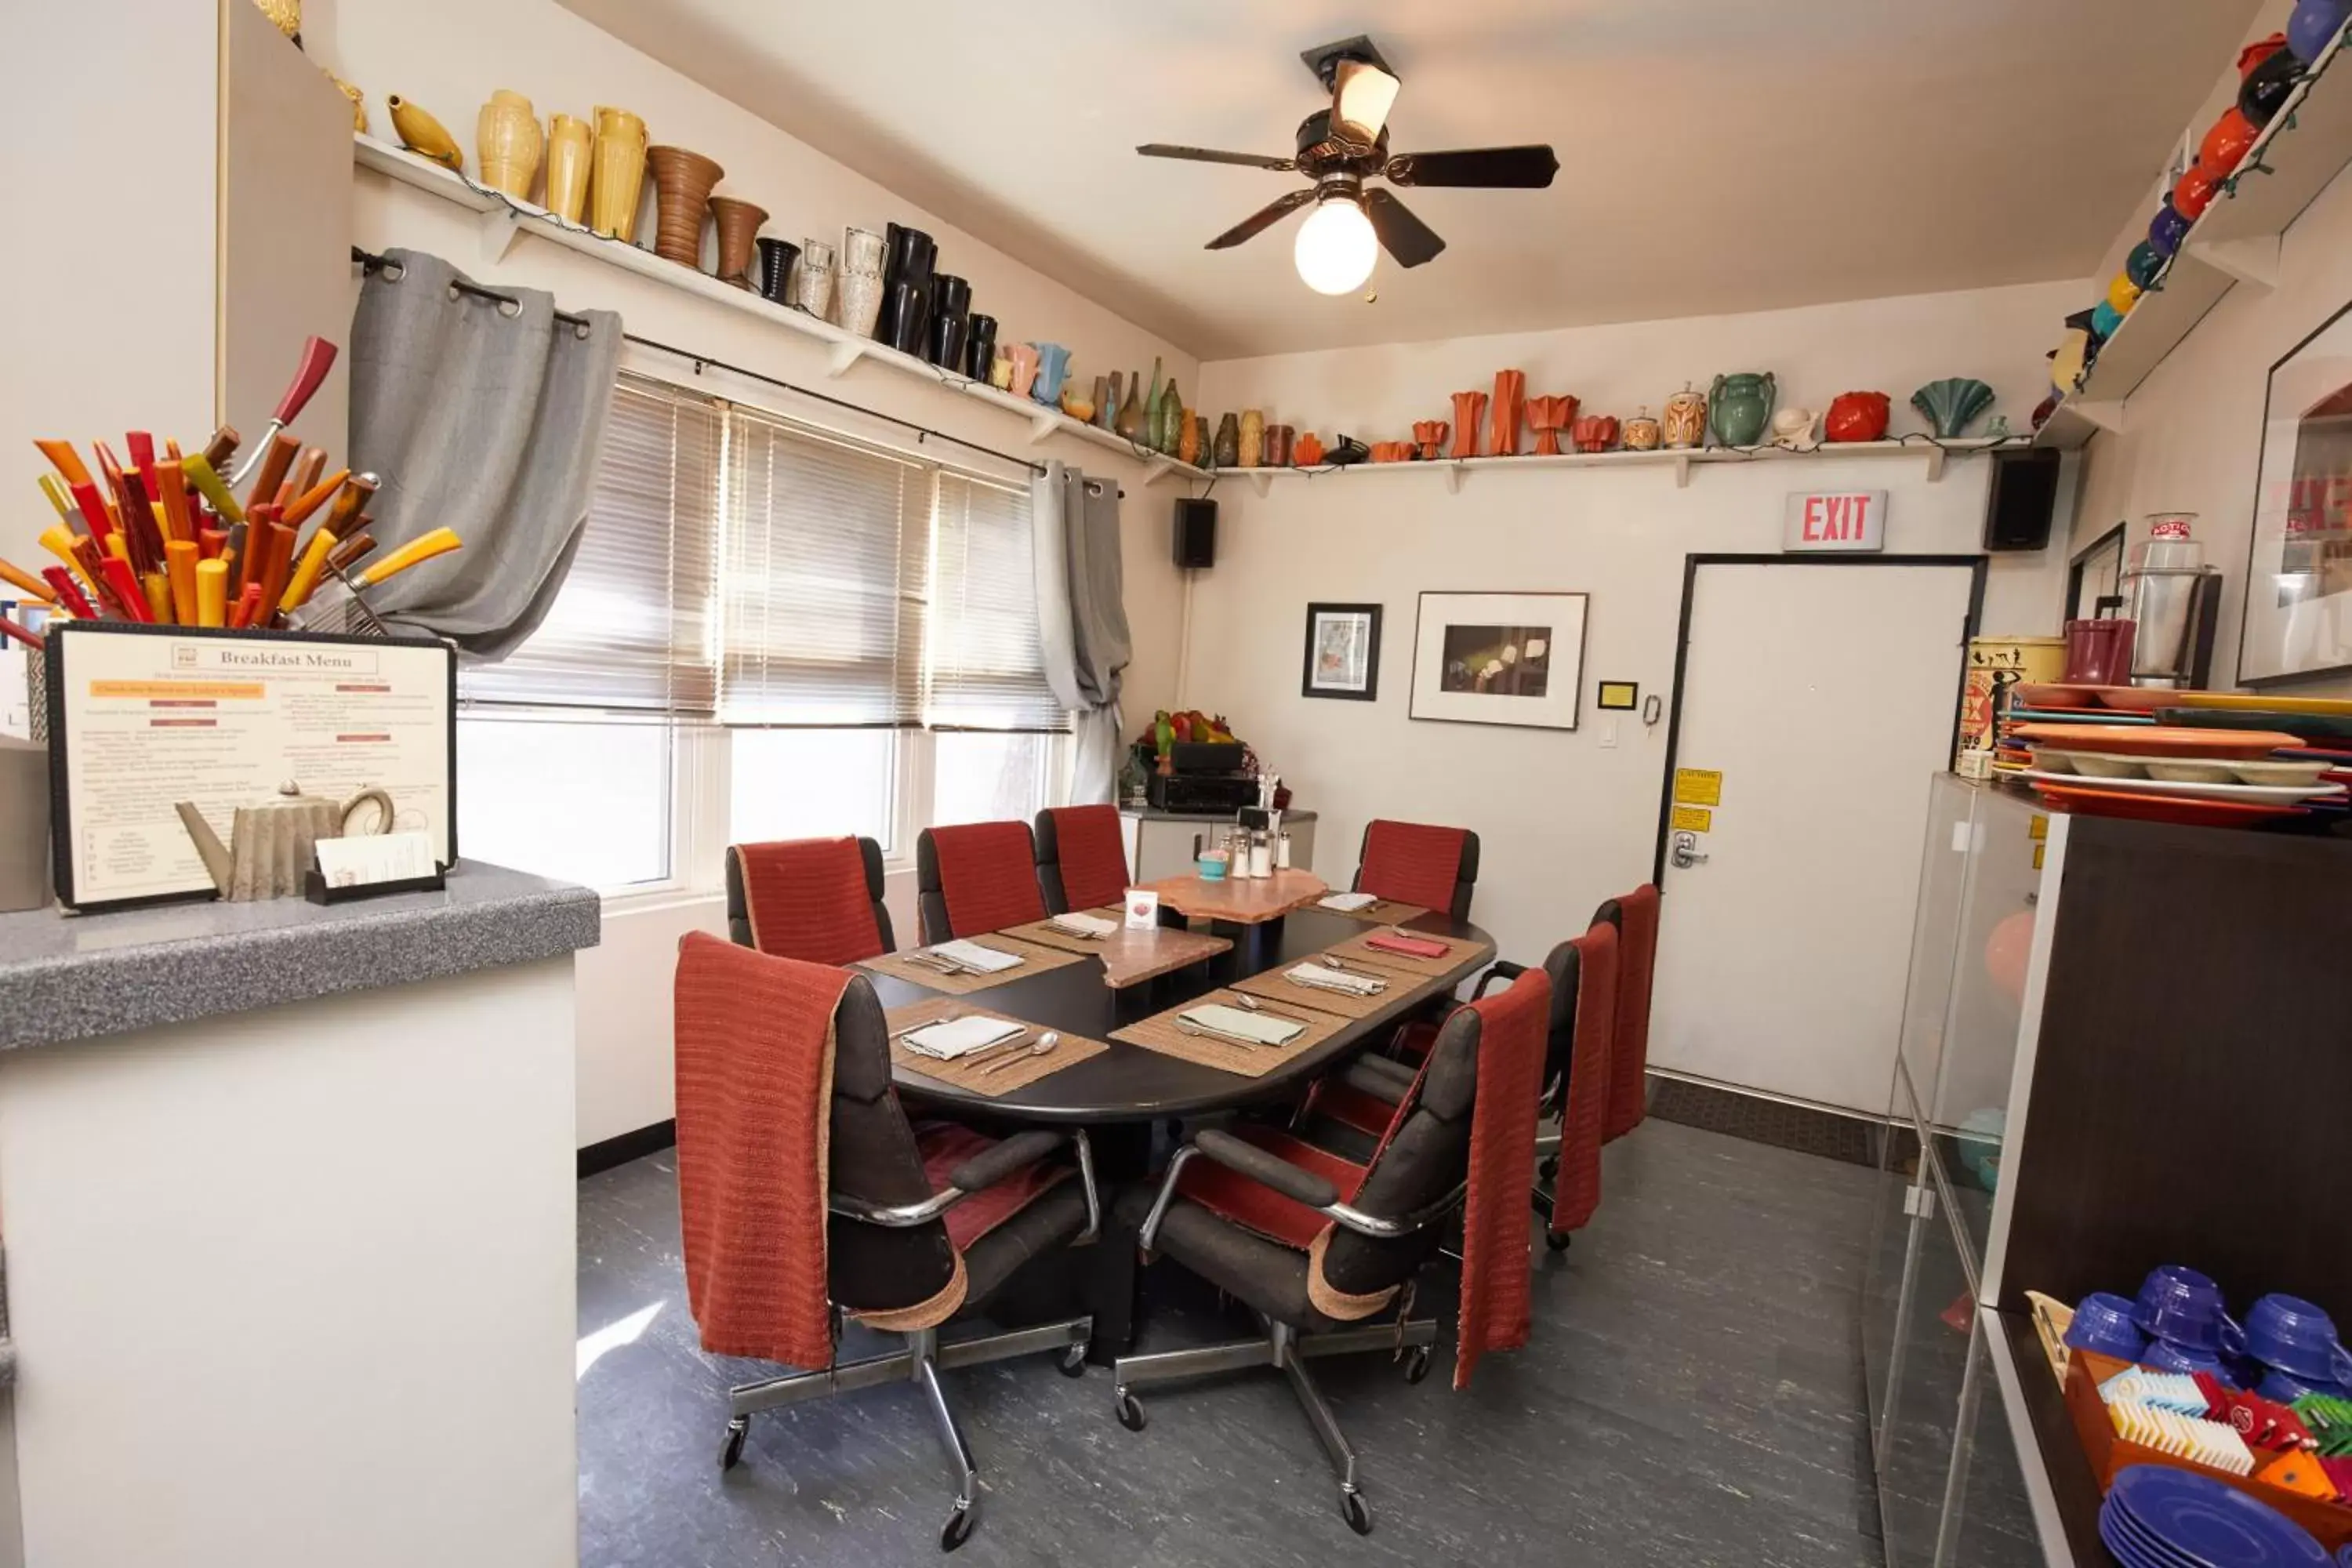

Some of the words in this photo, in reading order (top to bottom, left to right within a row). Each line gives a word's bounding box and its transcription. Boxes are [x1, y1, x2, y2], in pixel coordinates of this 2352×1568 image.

[1802, 496, 1871, 541] EXIT
[221, 651, 300, 666] Breakfast
[307, 654, 352, 668] Menu
